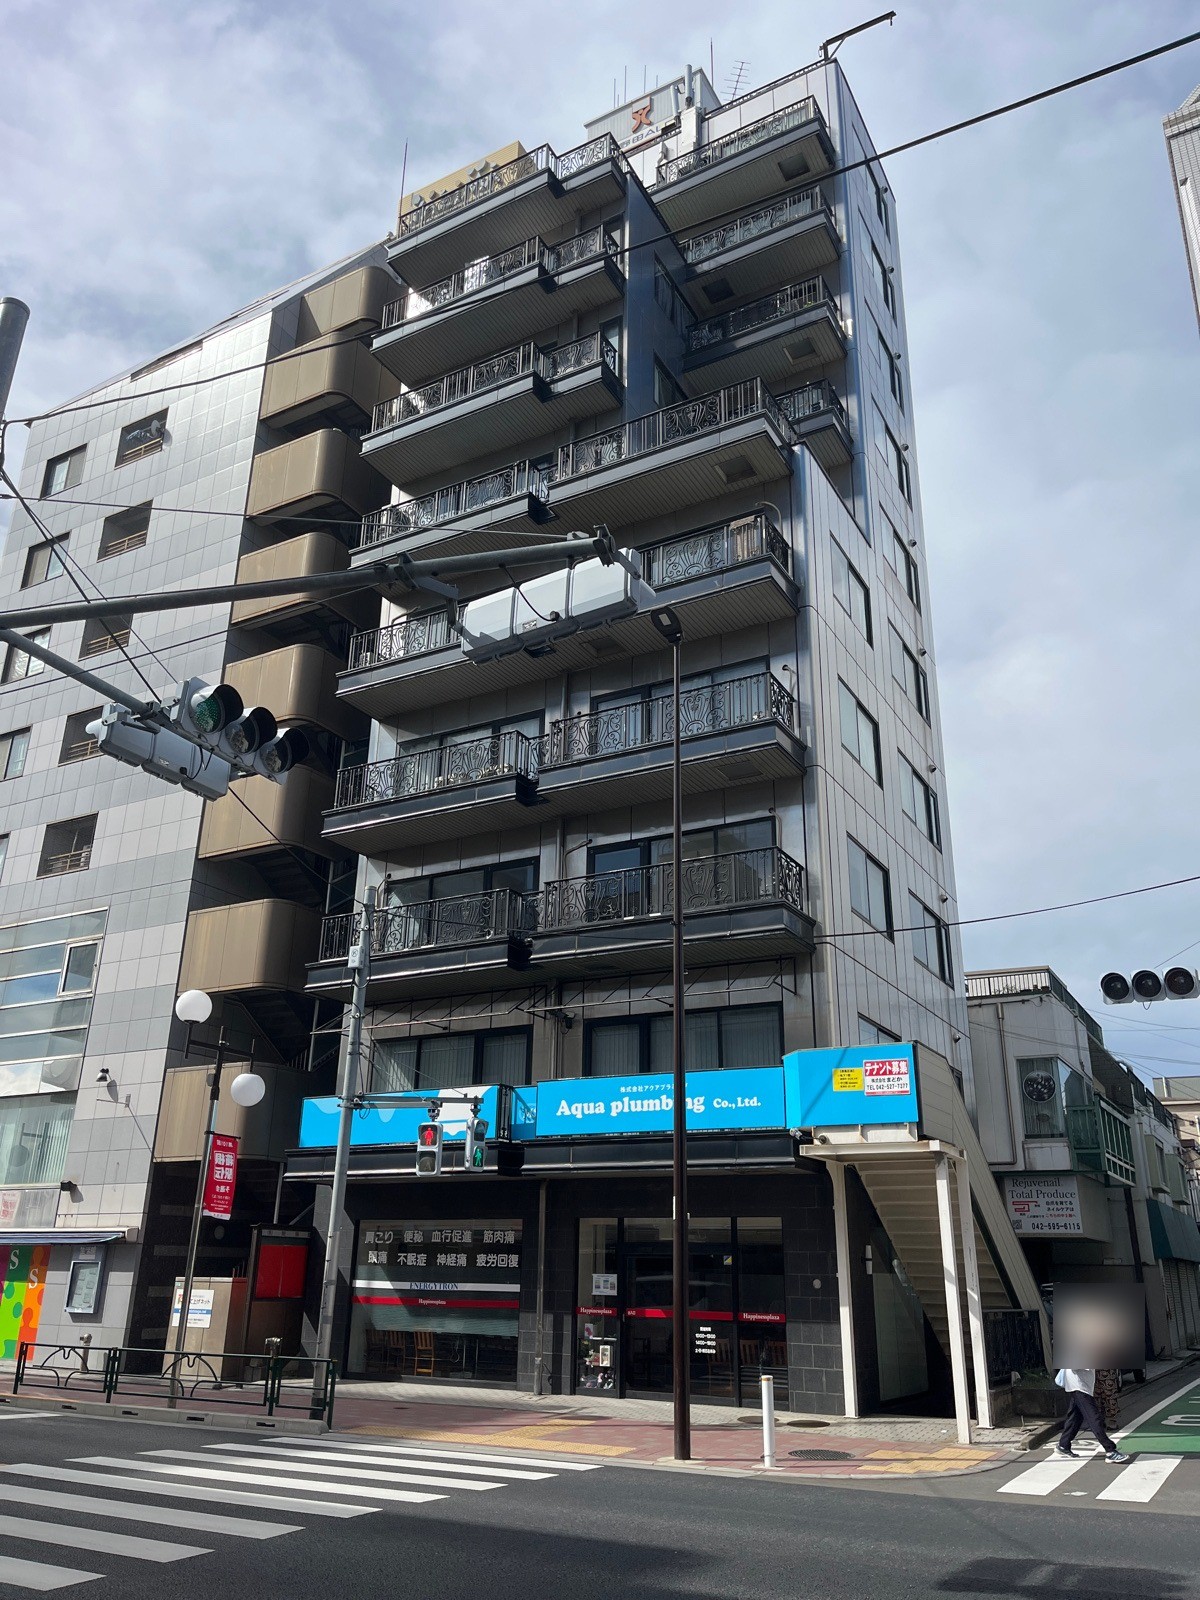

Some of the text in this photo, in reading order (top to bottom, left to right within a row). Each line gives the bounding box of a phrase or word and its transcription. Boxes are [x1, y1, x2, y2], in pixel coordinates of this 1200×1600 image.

[865, 1061, 908, 1075] テナント募集
[556, 1099, 606, 1119] Aqua
[610, 1094, 706, 1117] plumbng
[1012, 1178, 1061, 1189] Rejuvenail
[1008, 1189, 1076, 1199] Total Produce
[365, 1230, 515, 1244] 肩こり 便秘 血行促進 筋肉痛
[368, 1250, 519, 1268] 頭痛 不眠症 神経痛 疲労回復
